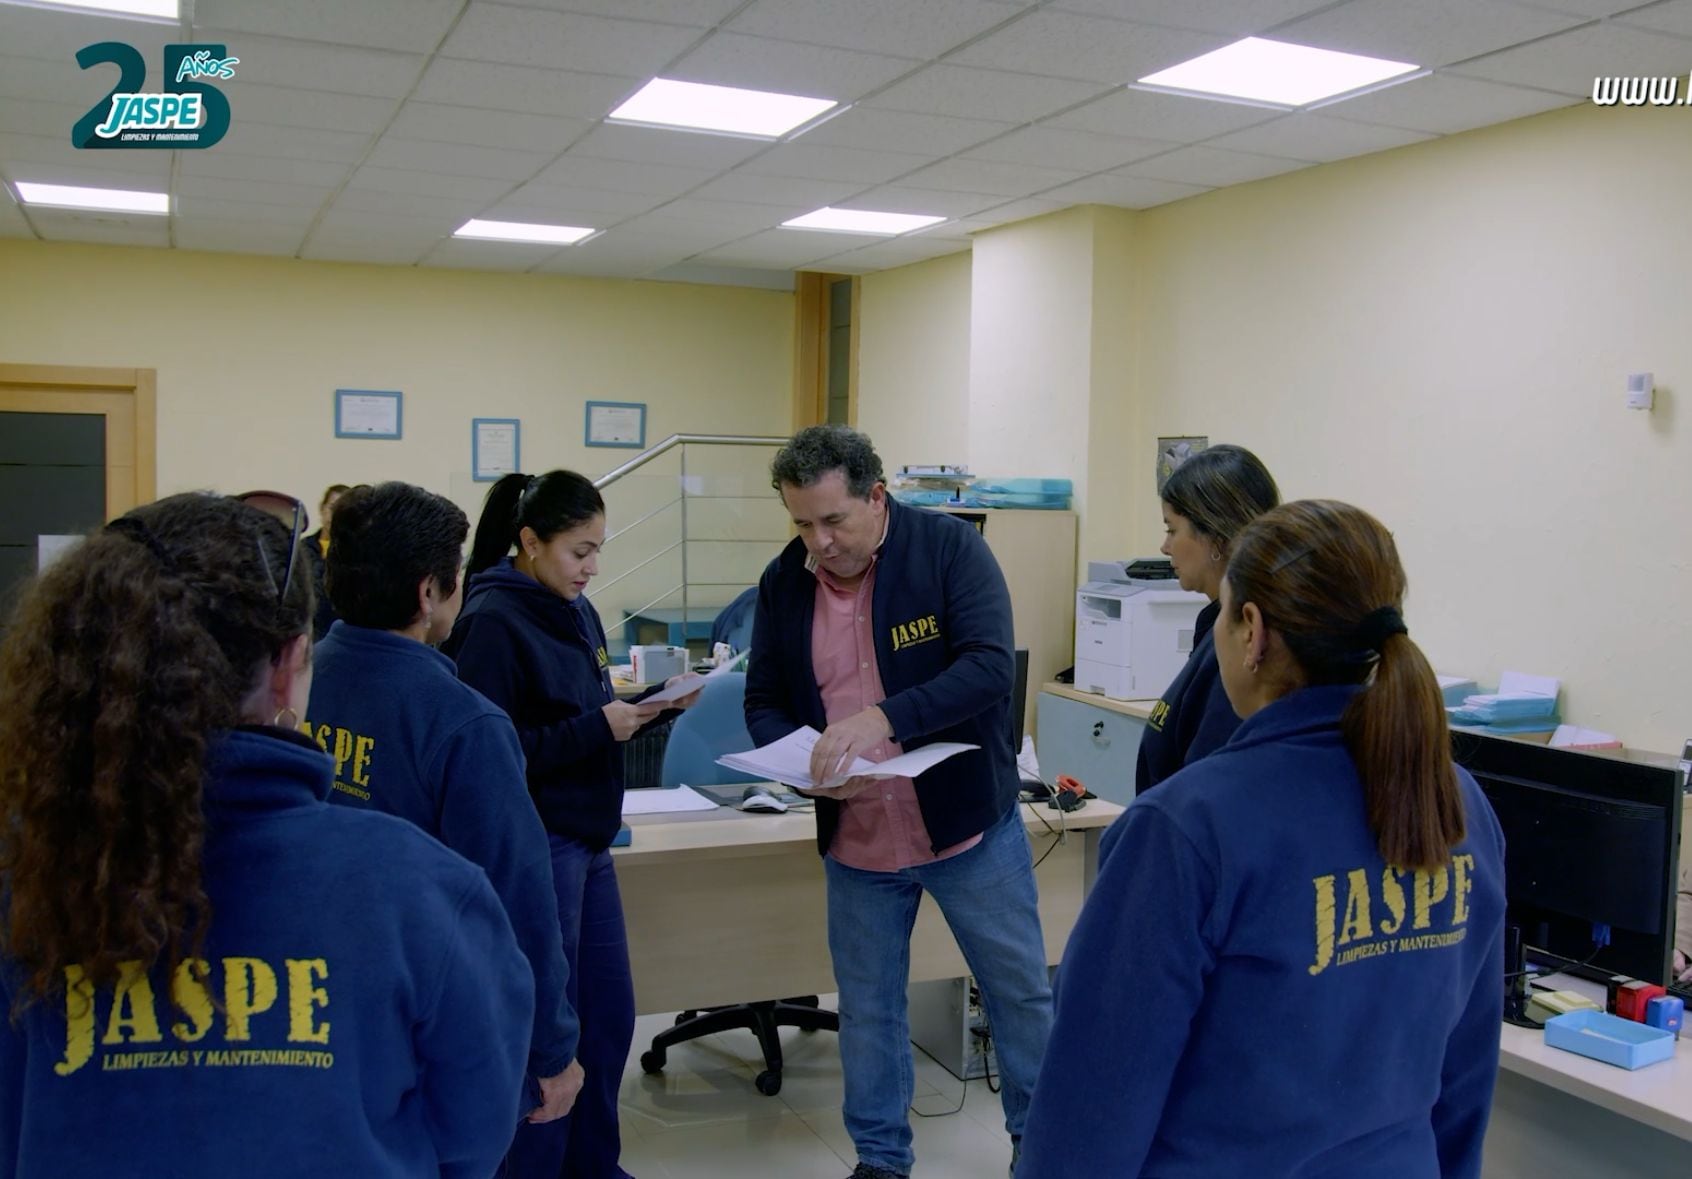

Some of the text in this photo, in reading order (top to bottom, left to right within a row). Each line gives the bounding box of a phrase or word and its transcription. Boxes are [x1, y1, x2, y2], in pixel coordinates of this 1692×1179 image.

[891, 615, 939, 651] JASPE
[1308, 854, 1474, 976] JASPE
[1336, 940, 1388, 966] LIMPIEZAS
[1389, 939, 1398, 953] Y
[54, 957, 331, 1076] JASPE
[102, 1050, 334, 1071] LIMPIEZAS Y MANTENIMIENTO
